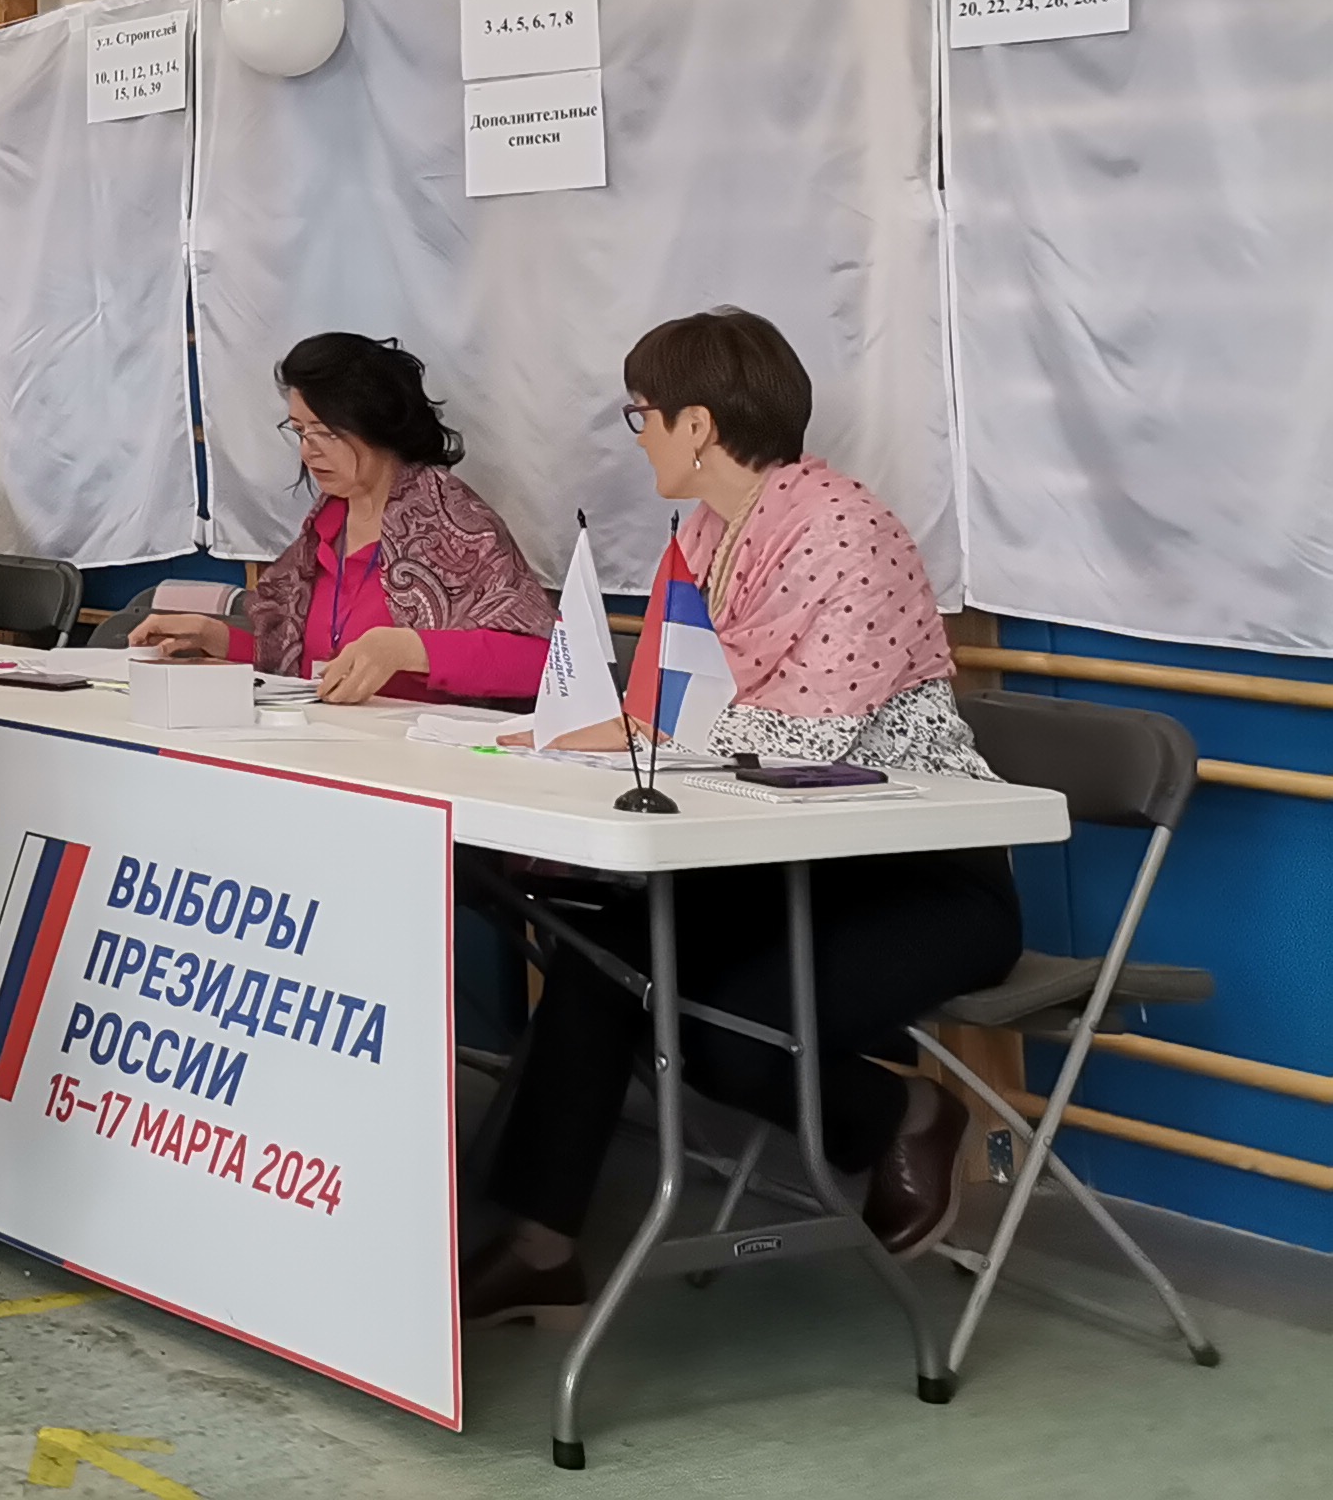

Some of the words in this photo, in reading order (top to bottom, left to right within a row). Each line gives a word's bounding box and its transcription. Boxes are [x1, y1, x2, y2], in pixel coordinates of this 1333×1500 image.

[484, 20, 492, 34] 3
[516, 16, 529, 32] 5,
[532, 14, 545, 29] 6,
[548, 12, 562, 28] 7,
[565, 10, 574, 26] 8
[958, 1, 982, 17] 20,
[96, 38, 113, 51] ул.
[116, 21, 177, 46] Строителей
[95, 71, 110, 85] 10,
[114, 69, 129, 82] 11,
[132, 66, 147, 80] 12,
[149, 62, 164, 76] 13,
[166, 59, 180, 73] 14,
[114, 87, 130, 101] 15,
[133, 84, 147, 98] 16,
[149, 81, 161, 95] 39
[469, 105, 598, 132] Дополнительные
[508, 131, 561, 148] списки
[106, 855, 321, 956] ВЫБОРЫ
[83, 929, 388, 1065] ПРЕЗИДЕНТА
[60, 1002, 250, 1107] РОССИИ
[44, 1073, 133, 1140] 15–17
[130, 1102, 248, 1185] МАРТА
[251, 1143, 344, 1217] 2024
